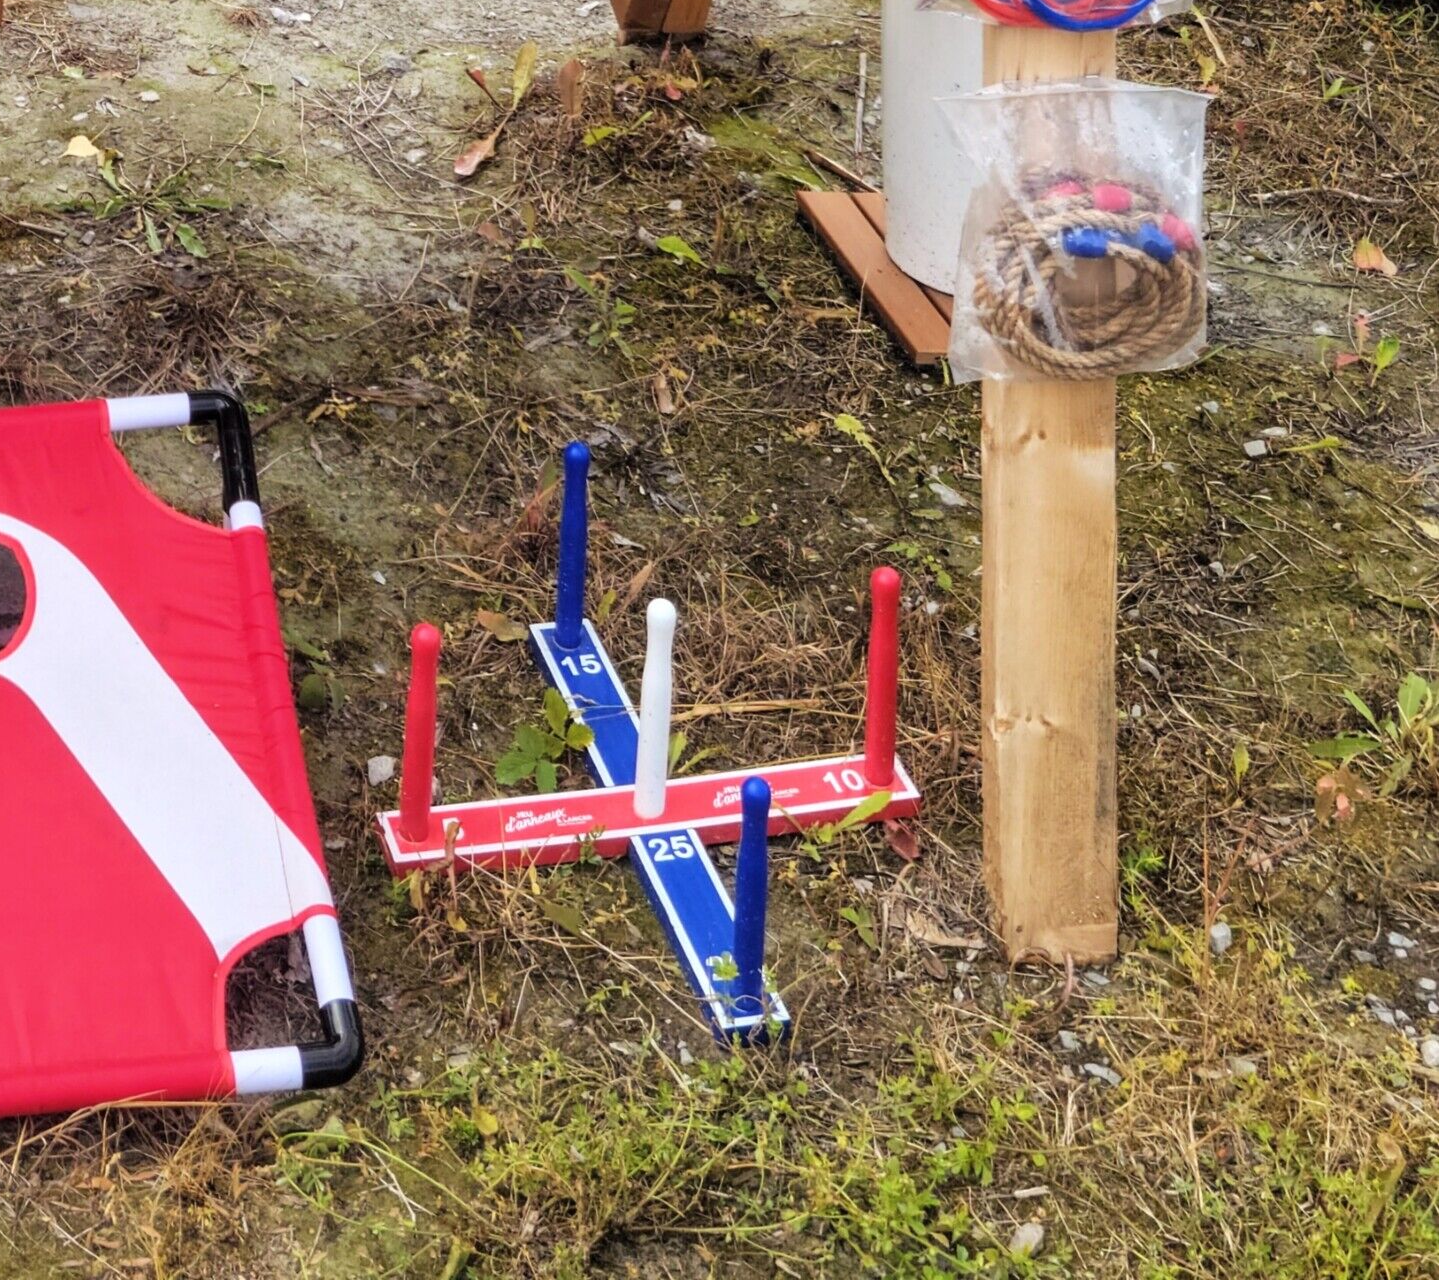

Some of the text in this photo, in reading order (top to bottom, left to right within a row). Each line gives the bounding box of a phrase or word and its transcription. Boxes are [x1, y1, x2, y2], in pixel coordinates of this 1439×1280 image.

[561, 654, 601, 676] 15
[823, 769, 865, 794] 10
[504, 808, 567, 833] d'anneaux
[648, 835, 694, 862] 25
